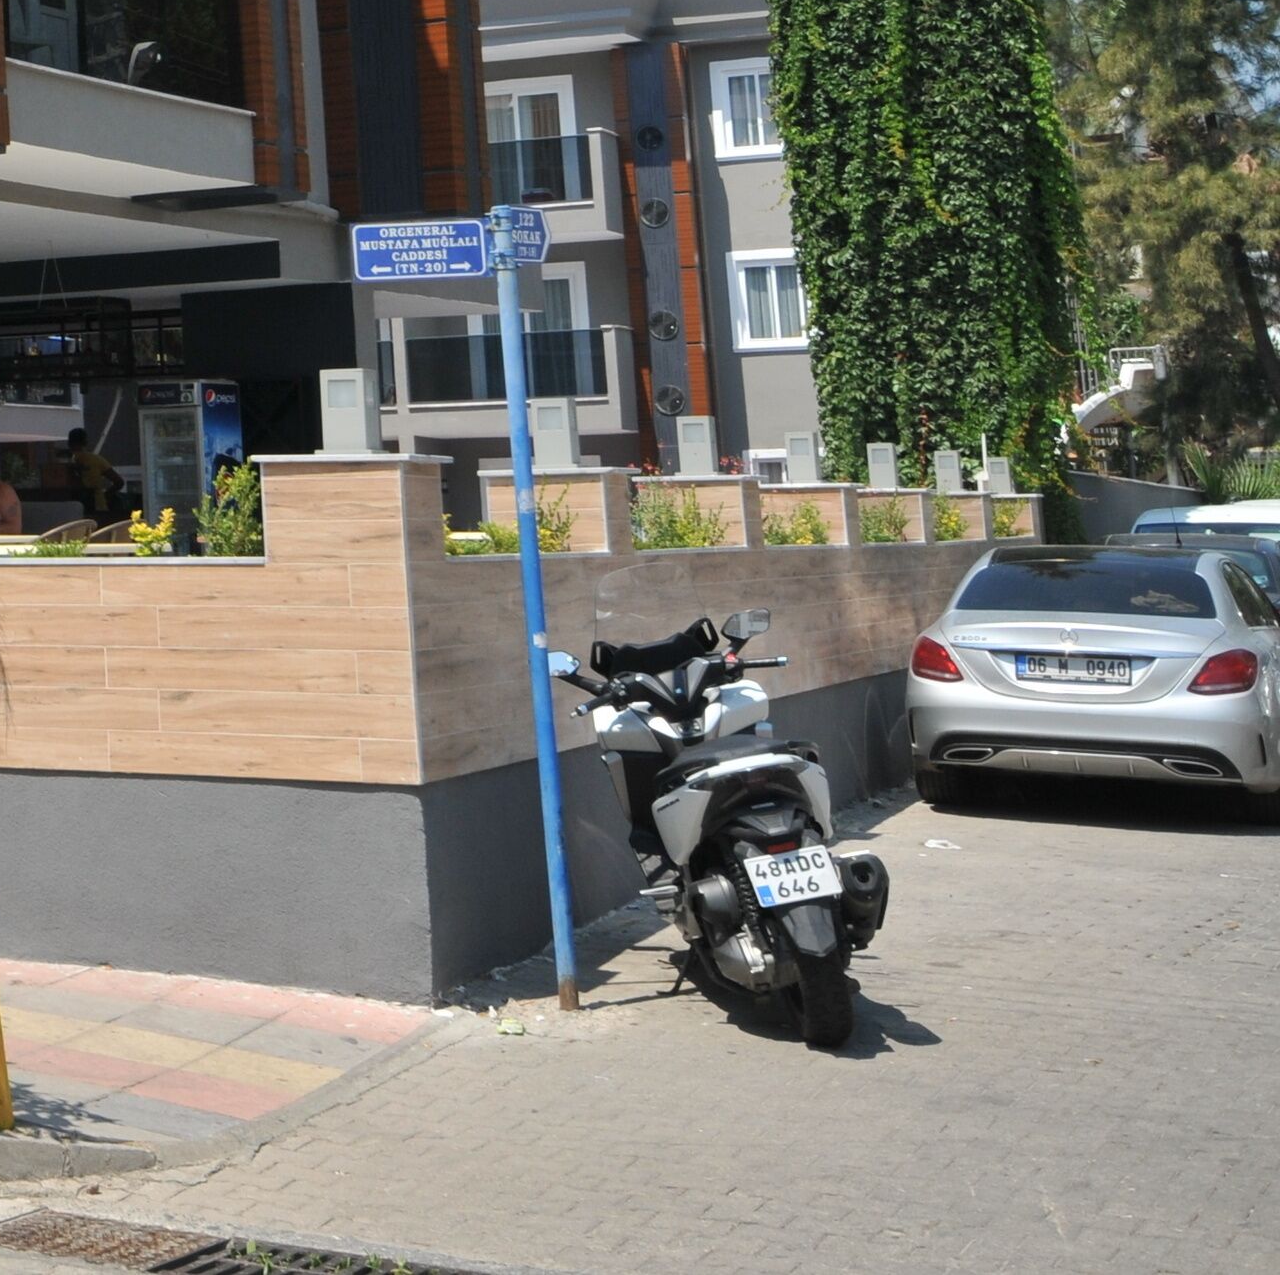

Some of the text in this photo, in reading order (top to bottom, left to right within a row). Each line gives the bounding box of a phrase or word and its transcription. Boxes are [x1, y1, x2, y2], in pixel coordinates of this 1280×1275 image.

[518, 212, 534, 227] 122
[380, 226, 457, 238] ORGENERAL
[512, 229, 541, 245] SOKAK
[360, 236, 478, 251] MUSTAFA MUĞLALI
[391, 248, 448, 262] CADDESİ
[395, 262, 447, 274] (TN-20)
[1028, 657, 1127, 677] 06 M 0940
[755, 853, 826, 880] 48ADC
[778, 876, 820, 898] 646
